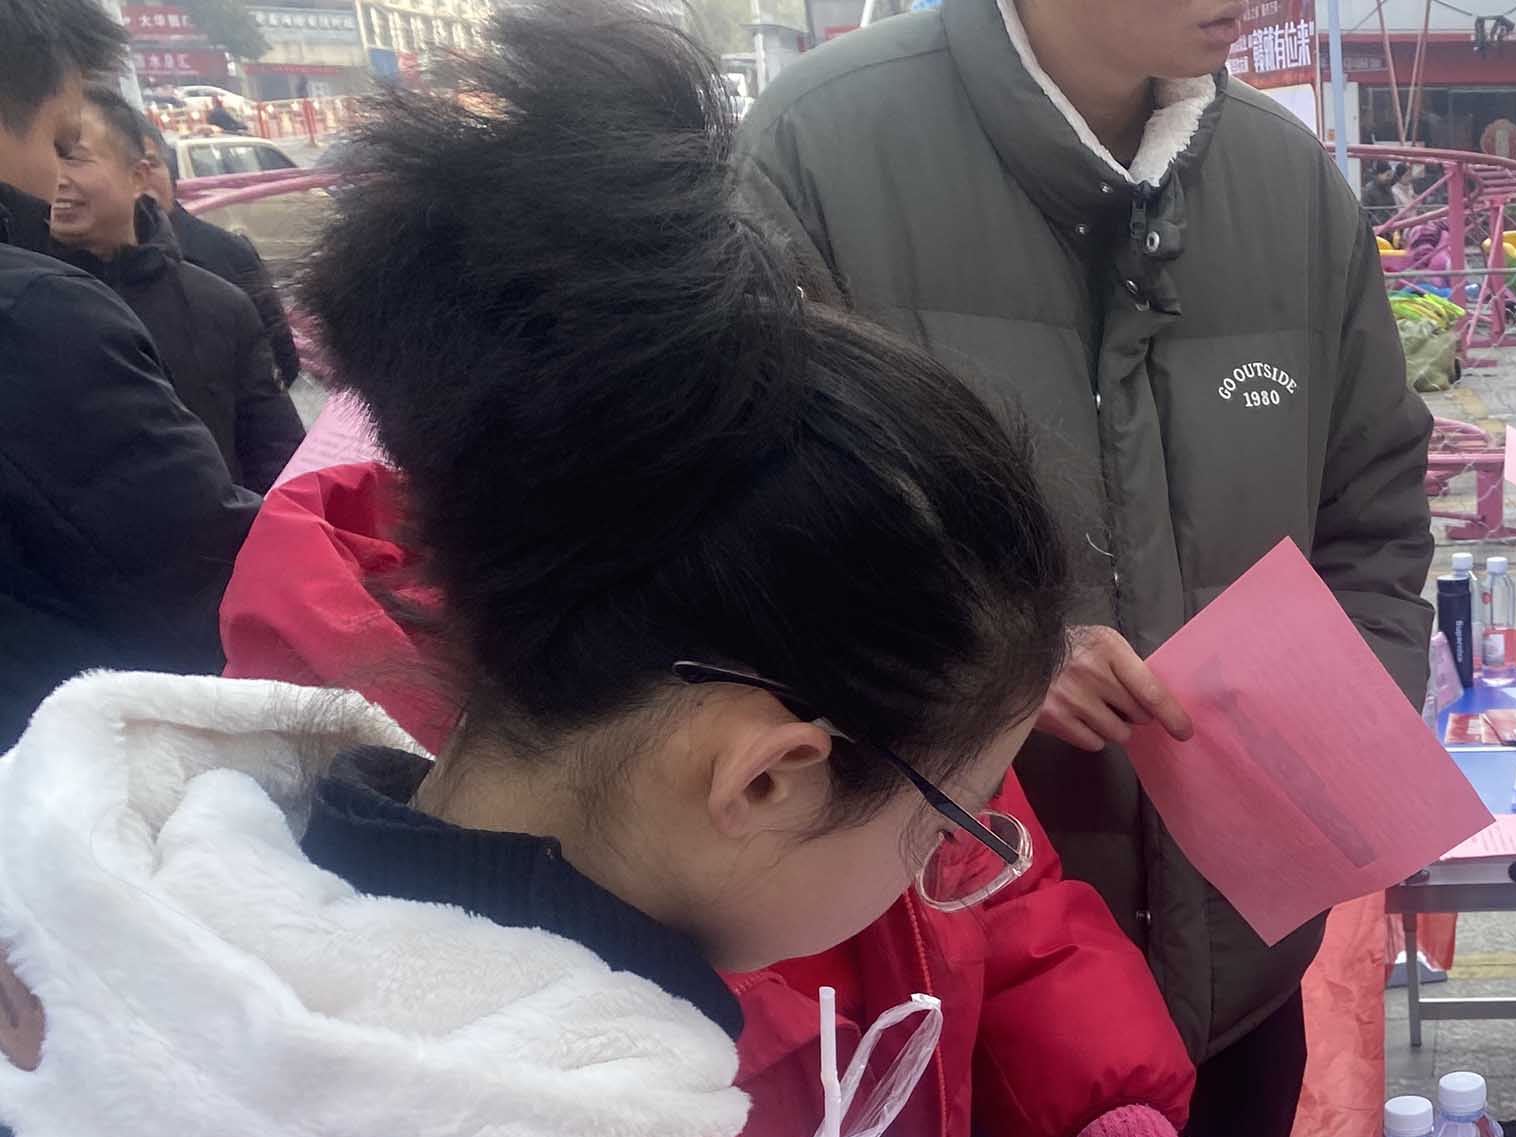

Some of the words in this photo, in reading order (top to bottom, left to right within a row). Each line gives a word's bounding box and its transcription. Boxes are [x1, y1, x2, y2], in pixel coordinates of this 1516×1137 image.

[1219, 381, 1237, 401] GO
[1233, 361, 1298, 395] OUTSIDE
[1244, 390, 1281, 409] 1980
